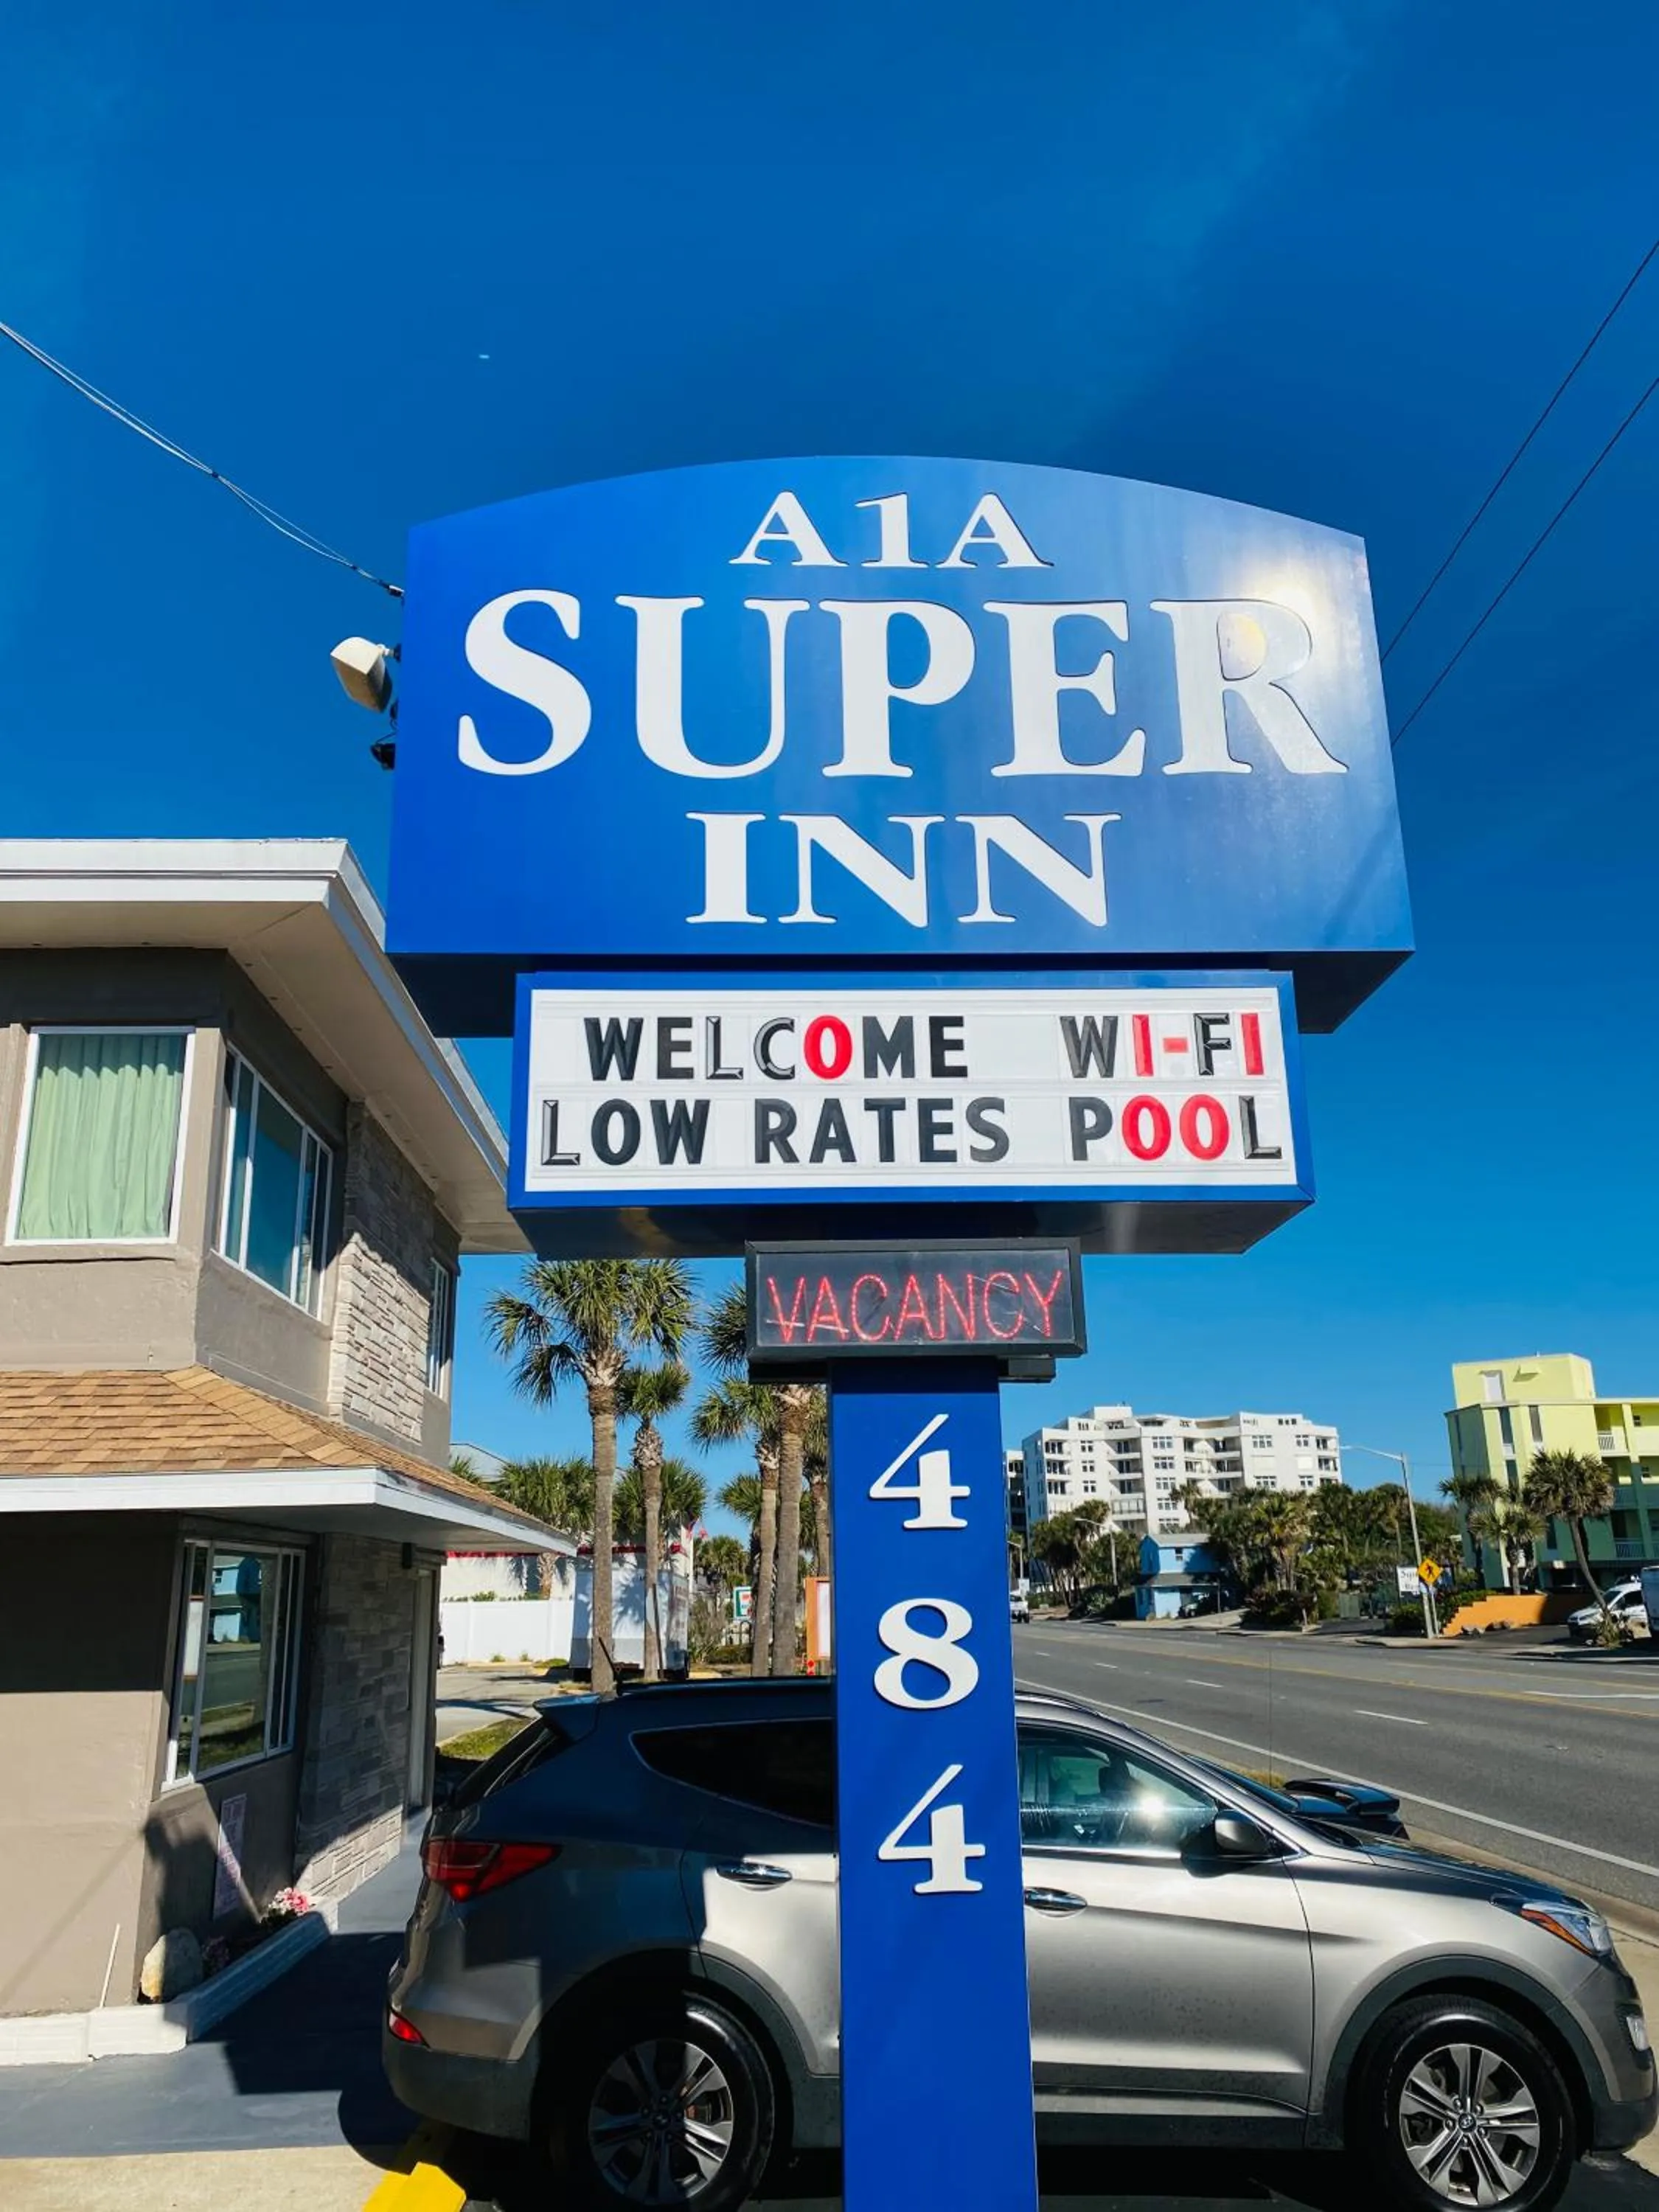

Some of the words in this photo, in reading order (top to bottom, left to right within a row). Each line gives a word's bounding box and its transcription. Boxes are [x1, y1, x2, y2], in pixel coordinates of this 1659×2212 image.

[728, 490, 1054, 569] A1A
[458, 588, 1349, 779] SUPER
[685, 813, 1122, 928] INN
[584, 1015, 967, 1082] WELCOME
[1059, 1012, 1265, 1079] WI-FI
[541, 1097, 711, 1165] LOW
[754, 1096, 1011, 1164] RATES
[1069, 1093, 1282, 1162] POOL
[768, 1270, 1062, 1343] VACANCY
